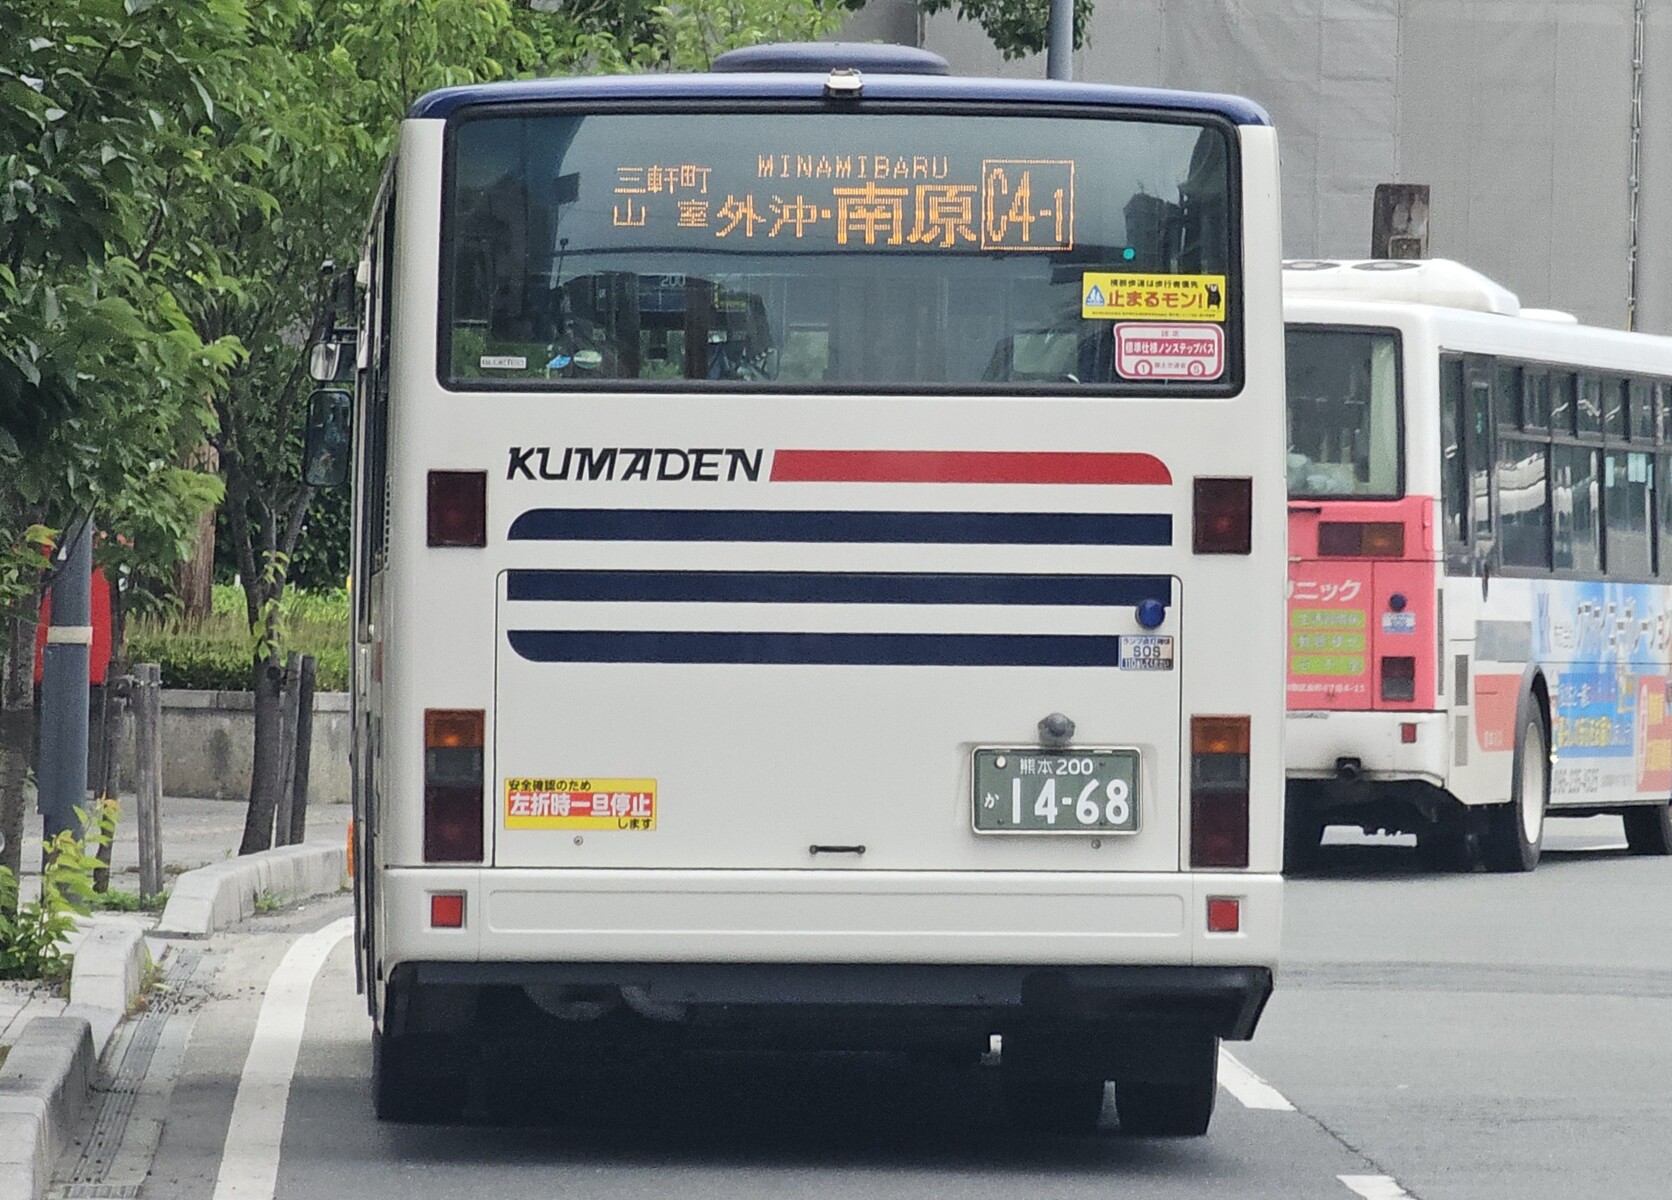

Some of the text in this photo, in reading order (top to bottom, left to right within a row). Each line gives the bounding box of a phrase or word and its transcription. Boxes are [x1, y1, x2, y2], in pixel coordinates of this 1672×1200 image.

[758, 154, 948, 178] MINAMIBARU
[614, 165, 712, 194] 三軒町
[987, 168, 1064, 242] C4-1
[1107, 290, 1203, 309] 止まるモン!
[506, 447, 764, 482] KUMADEN
[1133, 645, 1161, 658] SOS
[508, 779, 592, 792] 安全確認のため
[510, 792, 651, 817] 左折時一旦停止
[984, 778, 1129, 824] か 14-68
[617, 818, 653, 830] します
